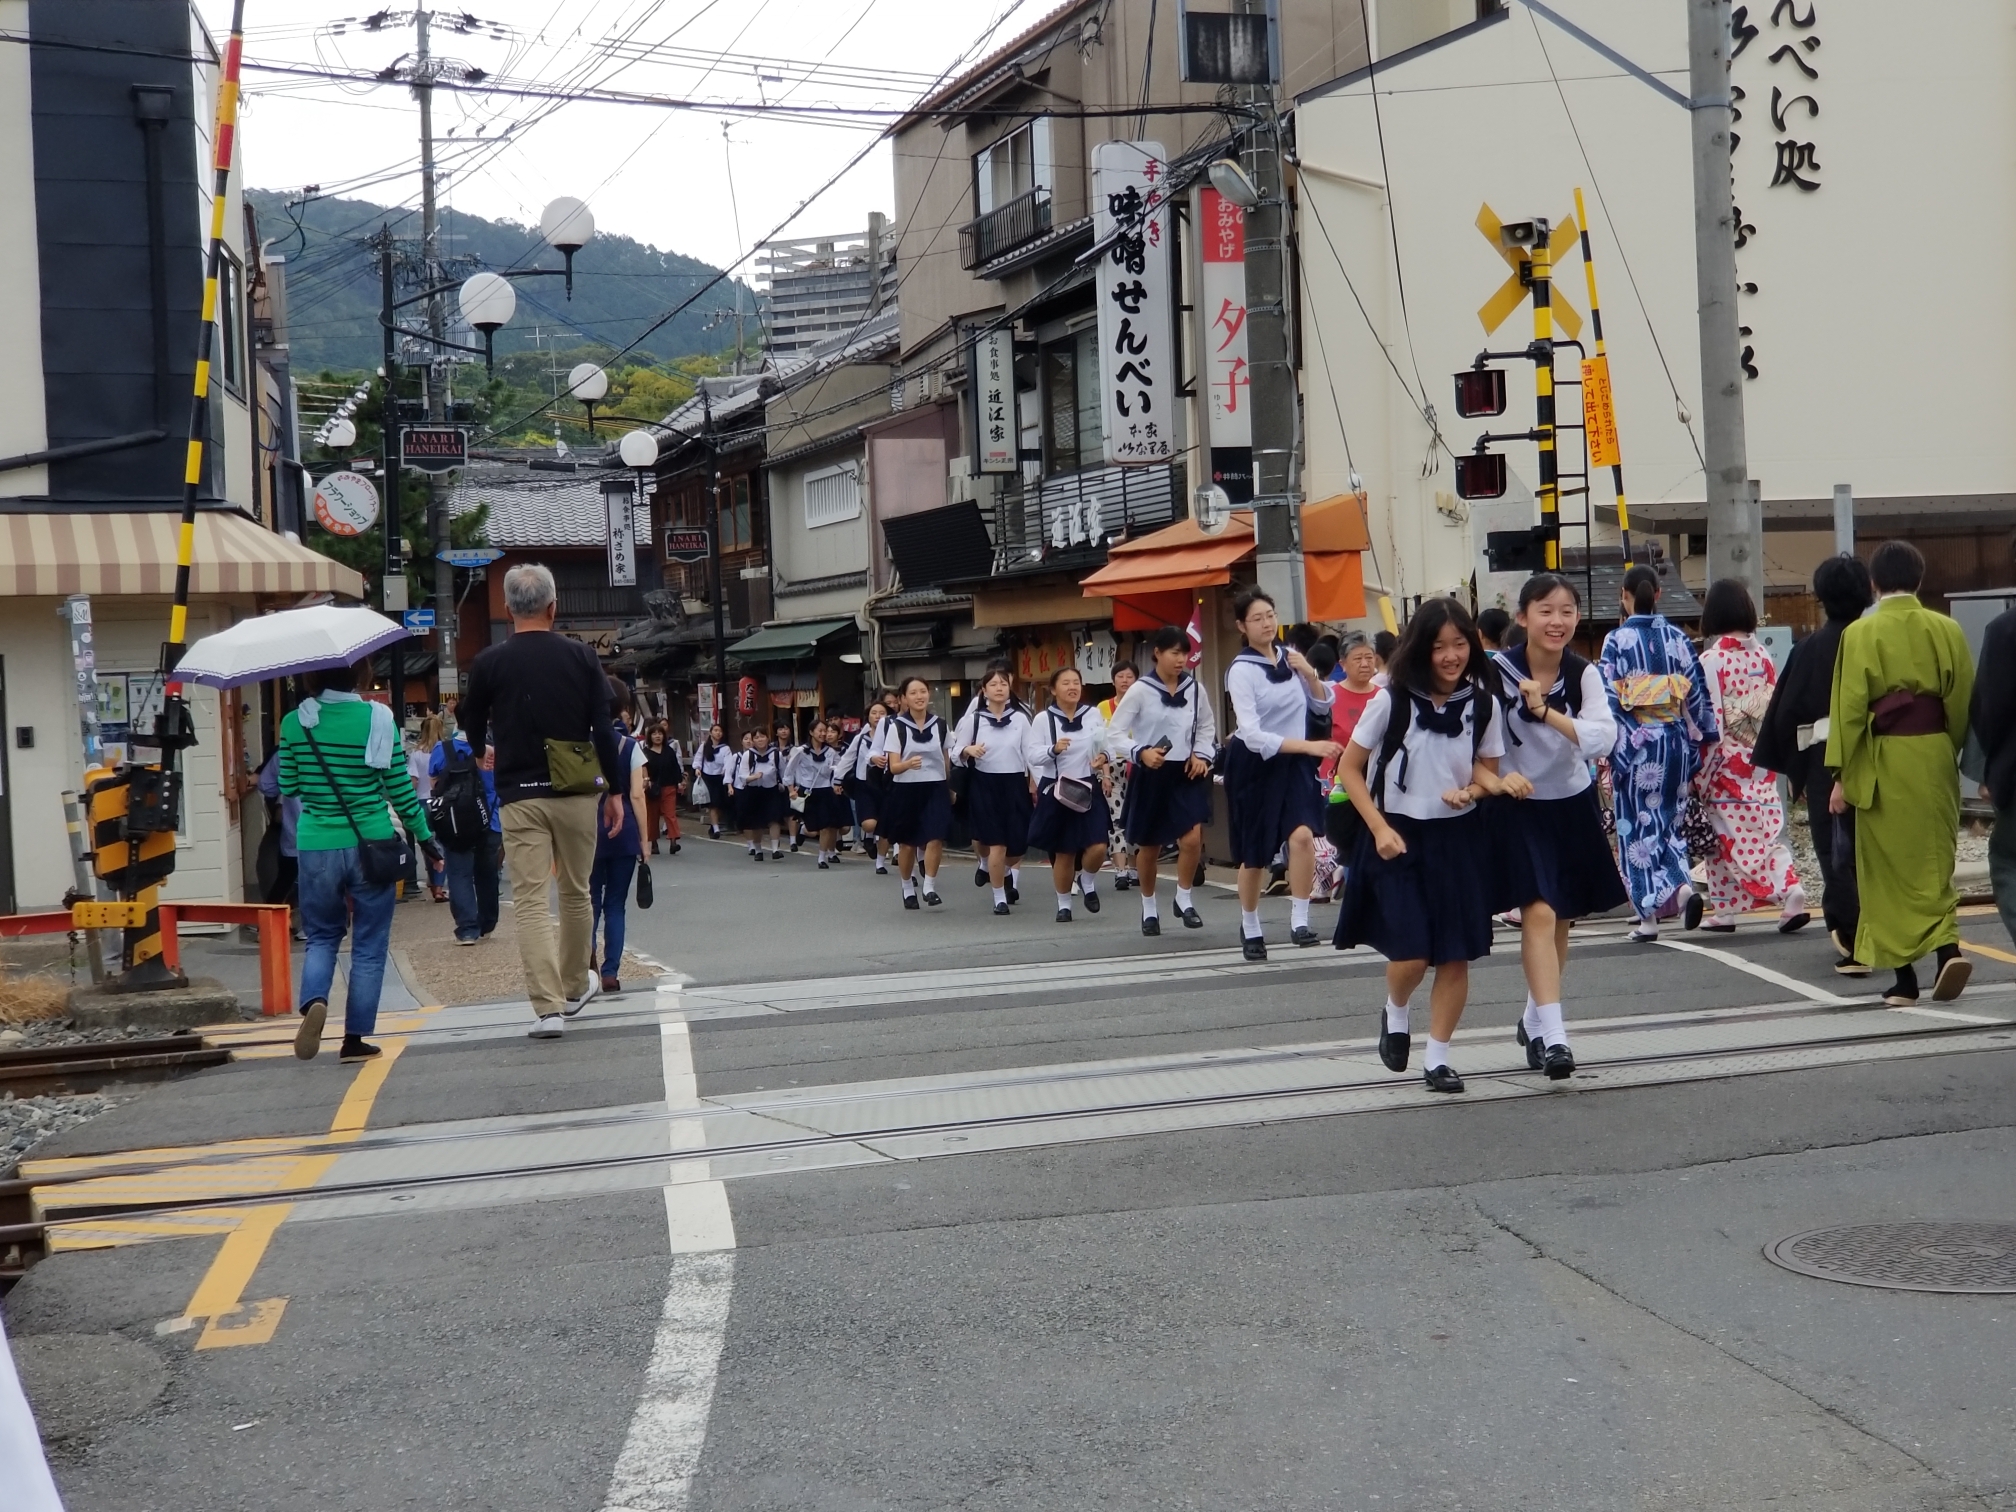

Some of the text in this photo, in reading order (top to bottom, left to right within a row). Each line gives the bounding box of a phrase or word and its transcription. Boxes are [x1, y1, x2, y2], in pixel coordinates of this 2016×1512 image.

[1768, 0, 1822, 193] んべい処
[1142, 159, 1162, 248] 手やき
[1217, 197, 1236, 259] おみやげ
[1107, 185, 1153, 418] 味噌せんべい
[988, 336, 1000, 382] お食事処
[1211, 297, 1252, 414] 夕子
[988, 388, 1005, 443] 近江家
[1213, 393, 1222, 420] ゆうこ
[1581, 364, 1602, 463] 押して出て下さい
[1598, 377, 1615, 445] とじこめられたら
[405, 444, 462, 455] HANEIKAI
[412, 433, 455, 443] INARI
[1128, 421, 1158, 439] 本家
[1222, 472, 1254, 481] 井筒八ッ
[323, 481, 369, 525] フラワーショップ
[622, 497, 632, 531] お食事処
[1051, 496, 1104, 549] 近江家
[669, 542, 708, 550] HANEIKAI
[673, 534, 702, 542] INARI
